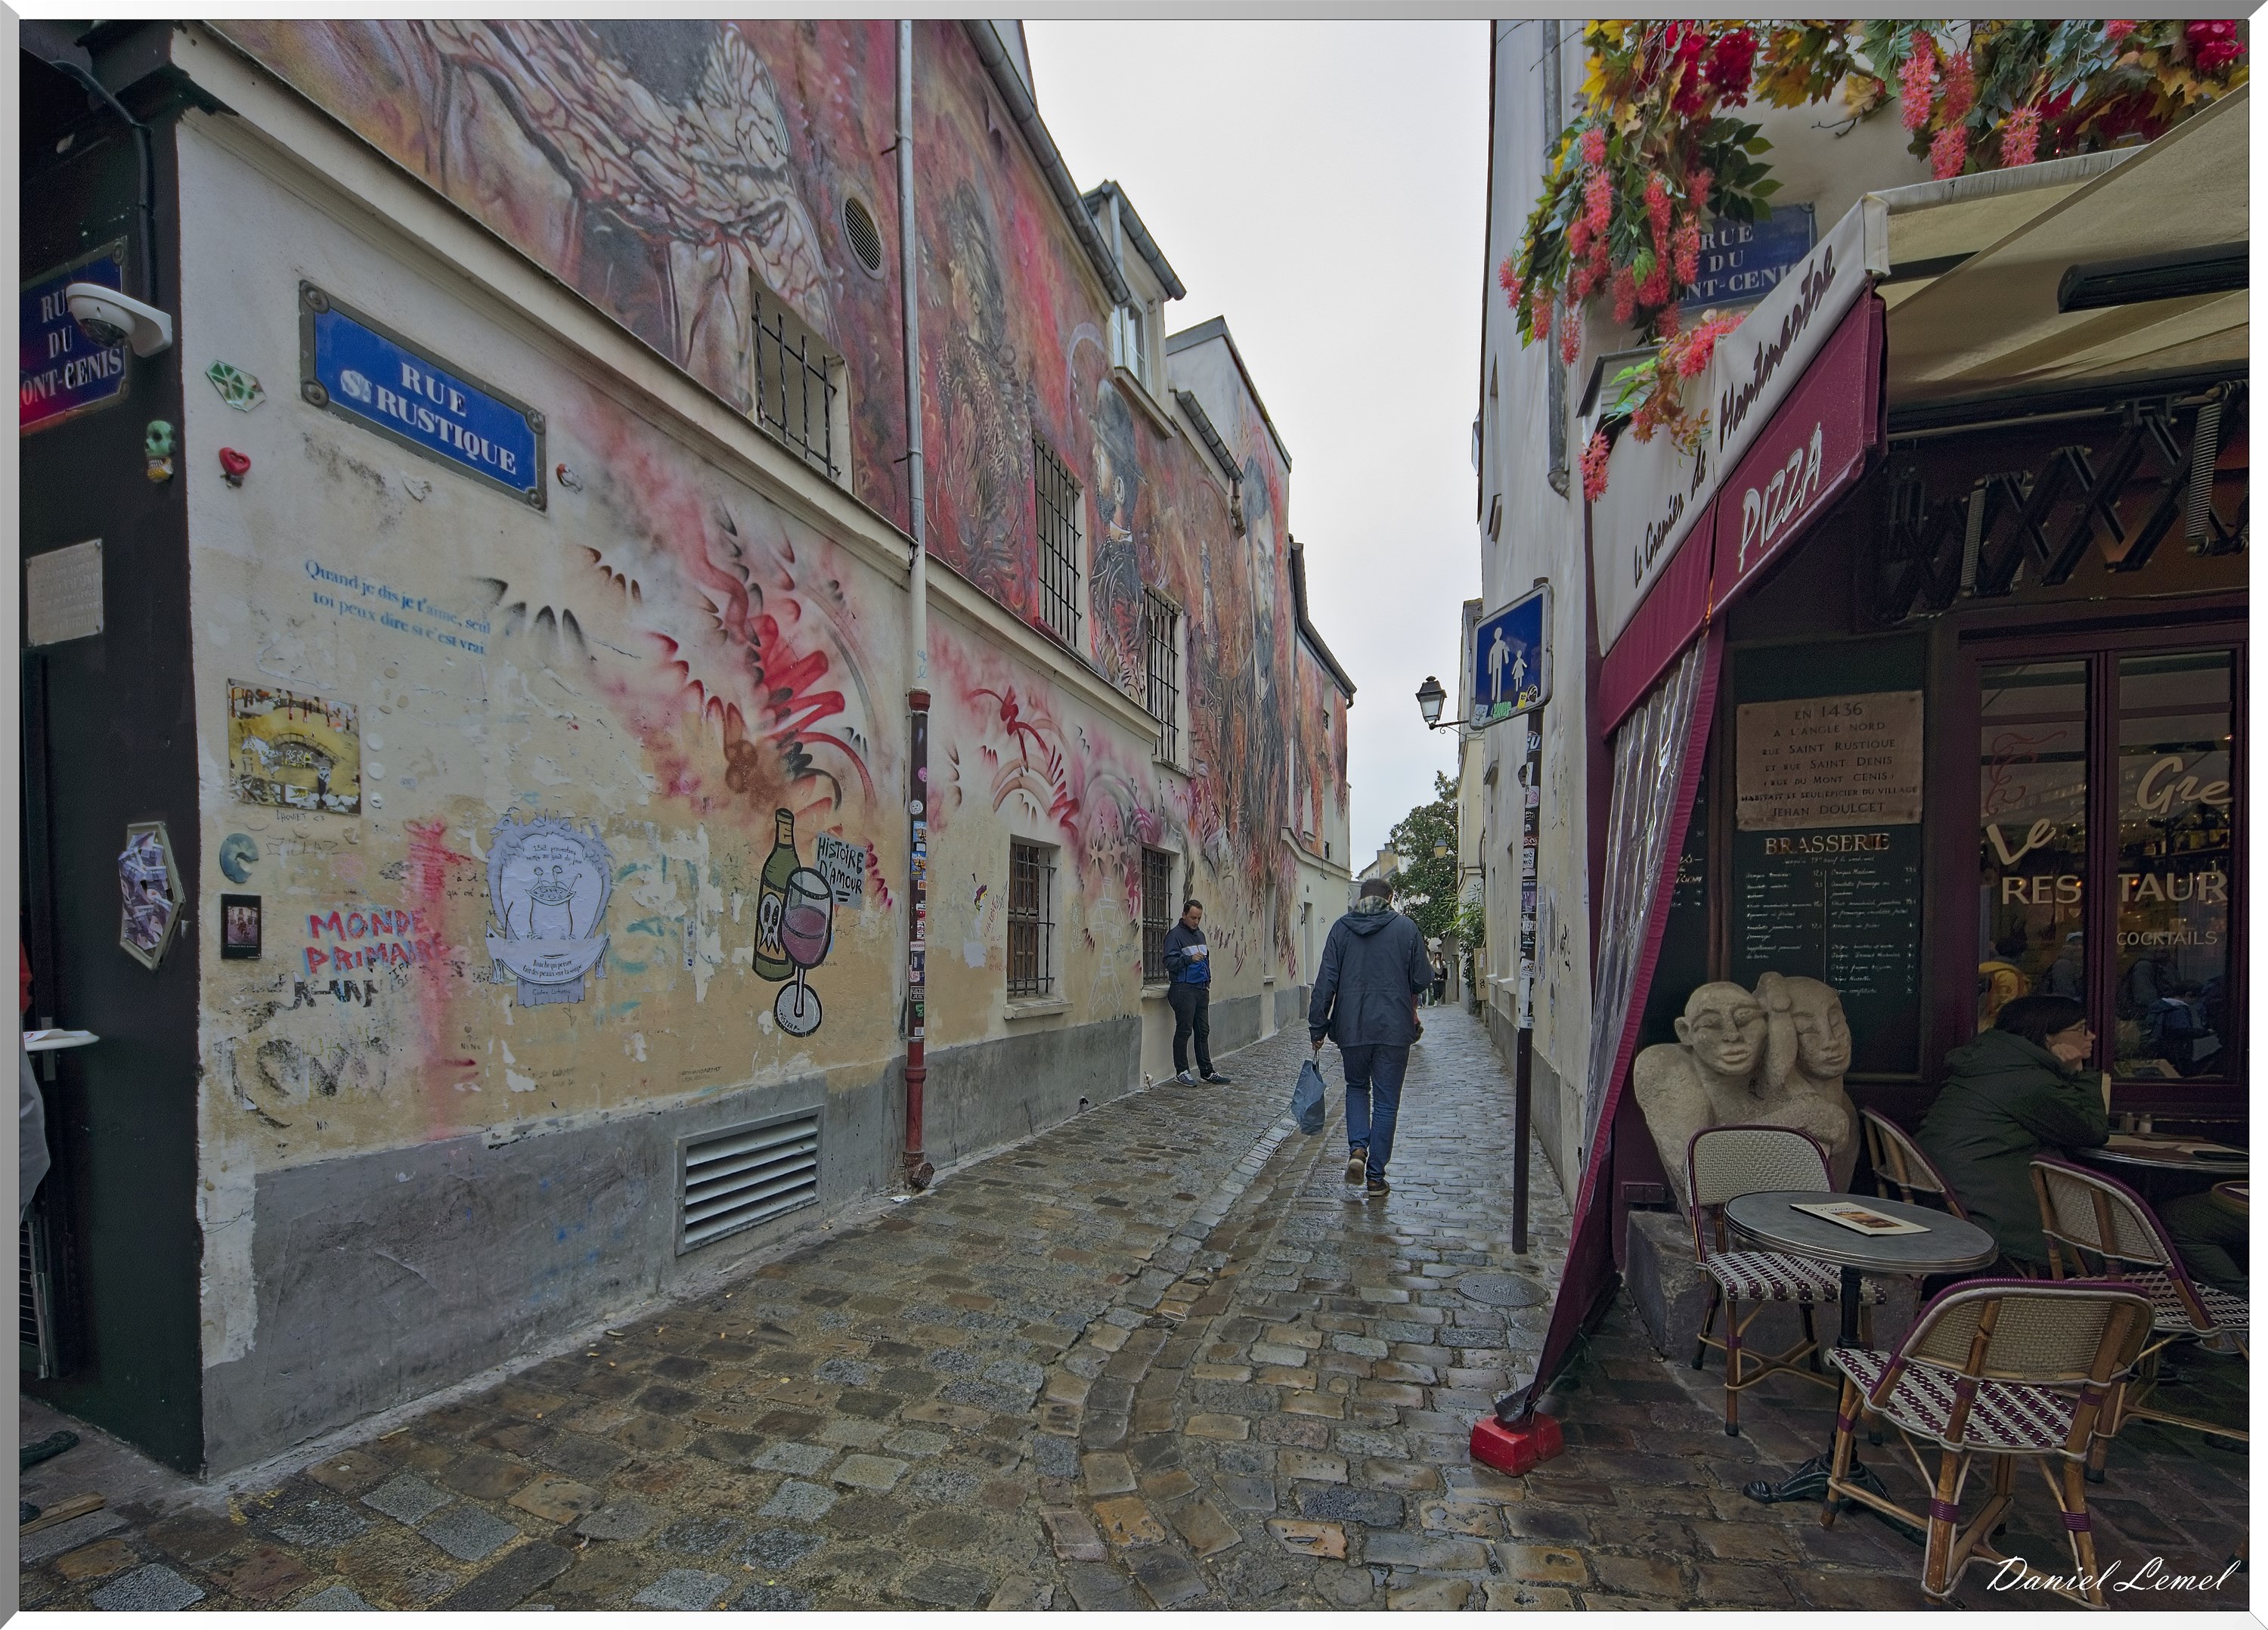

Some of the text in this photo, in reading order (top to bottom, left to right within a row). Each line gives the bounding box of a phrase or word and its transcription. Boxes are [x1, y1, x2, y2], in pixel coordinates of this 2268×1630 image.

[1701, 225, 1754, 251] RUE
[1709, 250, 1744, 273] DU
[42, 289, 71, 324] RU
[48, 325, 73, 359] DU
[1720, 244, 1837, 454] Montmartre
[20, 348, 123, 408] ONT-CENIS
[401, 362, 467, 417] RUE
[376, 385, 517, 476] RUSTIQUE
[1738, 421, 1823, 573] PIZZA
[305, 559, 359, 590] Quand
[361, 582, 375, 597] je
[378, 585, 398, 603] dis
[400, 591, 415, 610] je
[465, 618, 491, 635] seul
[312, 591, 334, 608] toi
[339, 600, 376, 622] peux
[380, 612, 409, 633] dire
[411, 623, 423, 637] si
[1795, 702, 1864, 720] EN 1436
[1790, 724, 1840, 737] L'ANGLE
[1850, 721, 1886, 733] NORD
[1762, 738, 1897, 756] RUE SAINT RUSTIQUE
[1783, 763, 1801, 771] RUE
[1810, 758, 1846, 770] SAINT
[1857, 756, 1893, 767] DENIS
[1795, 777, 1808, 786] DU
[1814, 776, 1844, 785] MONT
[1801, 791, 1821, 799] SEUL
[1862, 788, 1875, 796] DU
[1878, 786, 1919, 795] VILLAGE
[1772, 801, 1885, 818] JEHAN DOULCET
[1985, 756, 2234, 866] Le Gre
[1764, 832, 1891, 855] BRASSERIE
[820, 860, 863, 894] D'AMOUR
[2002, 872, 2229, 905] RES TAUR
[308, 907, 429, 942] MONDE
[2117, 931, 2218, 946] COCKTAILS
[305, 931, 452, 975] PRIMAIRE
